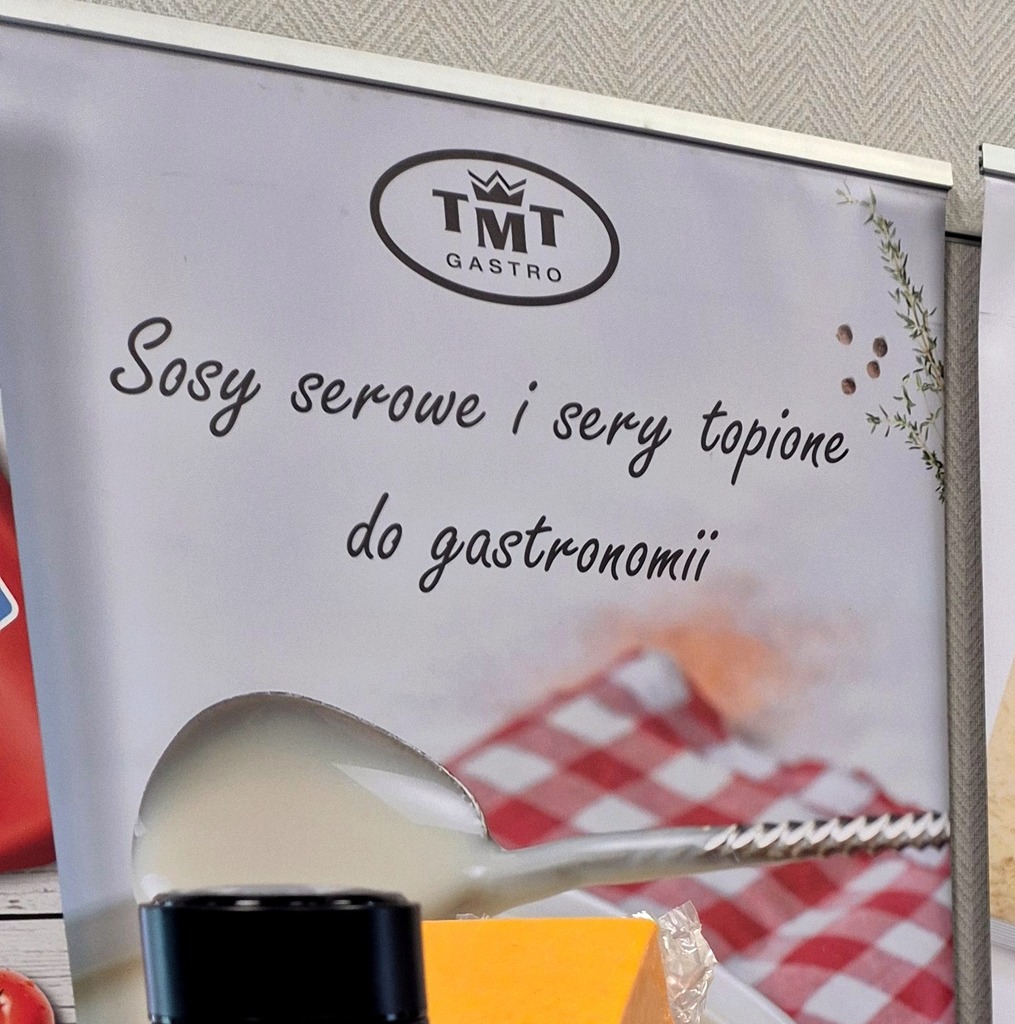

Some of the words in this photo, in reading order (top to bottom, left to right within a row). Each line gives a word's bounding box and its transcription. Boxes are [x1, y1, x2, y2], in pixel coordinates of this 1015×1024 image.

[432, 189, 564, 253] TMT
[446, 254, 563, 283] GASTRO
[110, 317, 261, 437] Sosy
[290, 372, 486, 429] serowe
[512, 380, 538, 434] i
[553, 402, 672, 478] sery
[700, 400, 849, 486] topione
[347, 491, 403, 559] do
[419, 515, 719, 592] gastronomii
